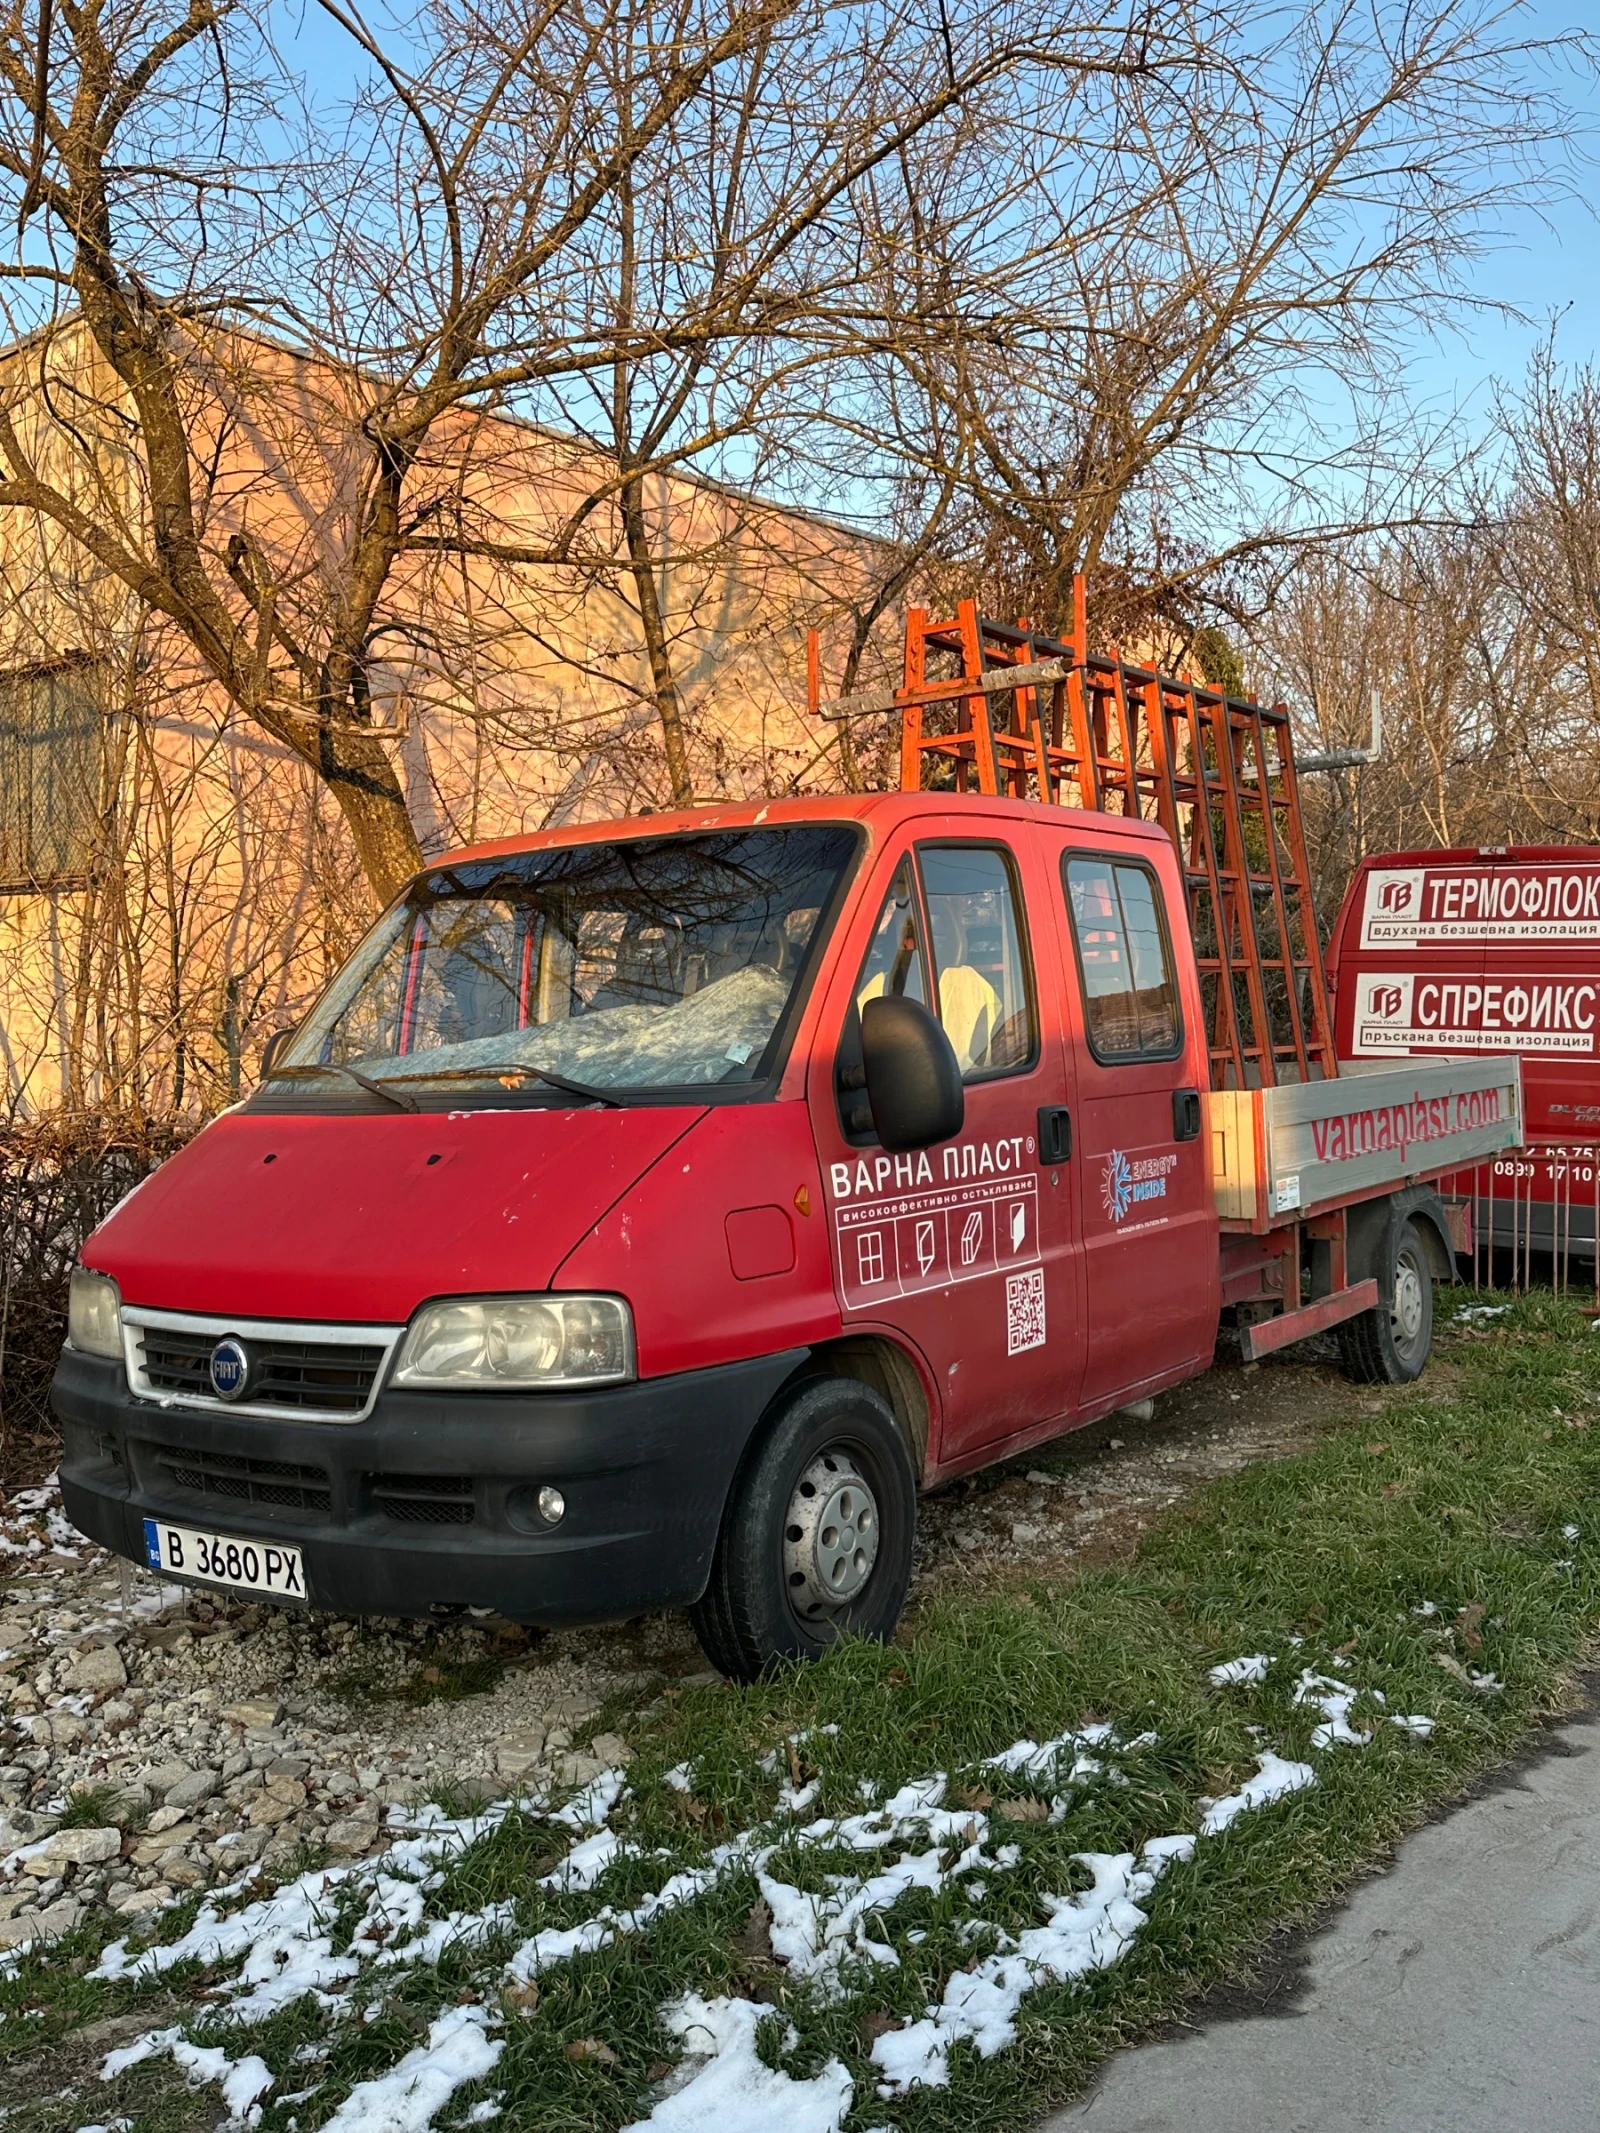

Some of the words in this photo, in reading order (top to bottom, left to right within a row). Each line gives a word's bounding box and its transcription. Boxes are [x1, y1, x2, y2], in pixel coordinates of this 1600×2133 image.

[1430, 875, 1600, 919] ТЕРМОФЛОК
[1374, 926, 1435, 938] вдухана
[1440, 924, 1516, 936] безшевна
[1521, 924, 1598, 936] изолация
[1418, 983, 1596, 1030] СПРЕФИКС
[1365, 1032, 1434, 1044] пръскана
[1438, 1032, 1511, 1045] безшевна
[1516, 1034, 1591, 1048] изолация
[1311, 1087, 1504, 1163] varnaplast.com
[830, 1151, 934, 1198] ВАРНА
[943, 1137, 1024, 1180] ПЛАСТ
[1494, 1161, 1535, 1177] 0899
[1572, 1166, 1593, 1182] 10
[843, 1194, 958, 1223] високоефективно
[962, 1179, 1033, 1201] остъкляване
[1133, 1177, 1167, 1202] INSIDE
[214, 1360, 239, 1379] FIAT
[150, 1550, 160, 1561] BG
[197, 1538, 259, 1583] 3680
